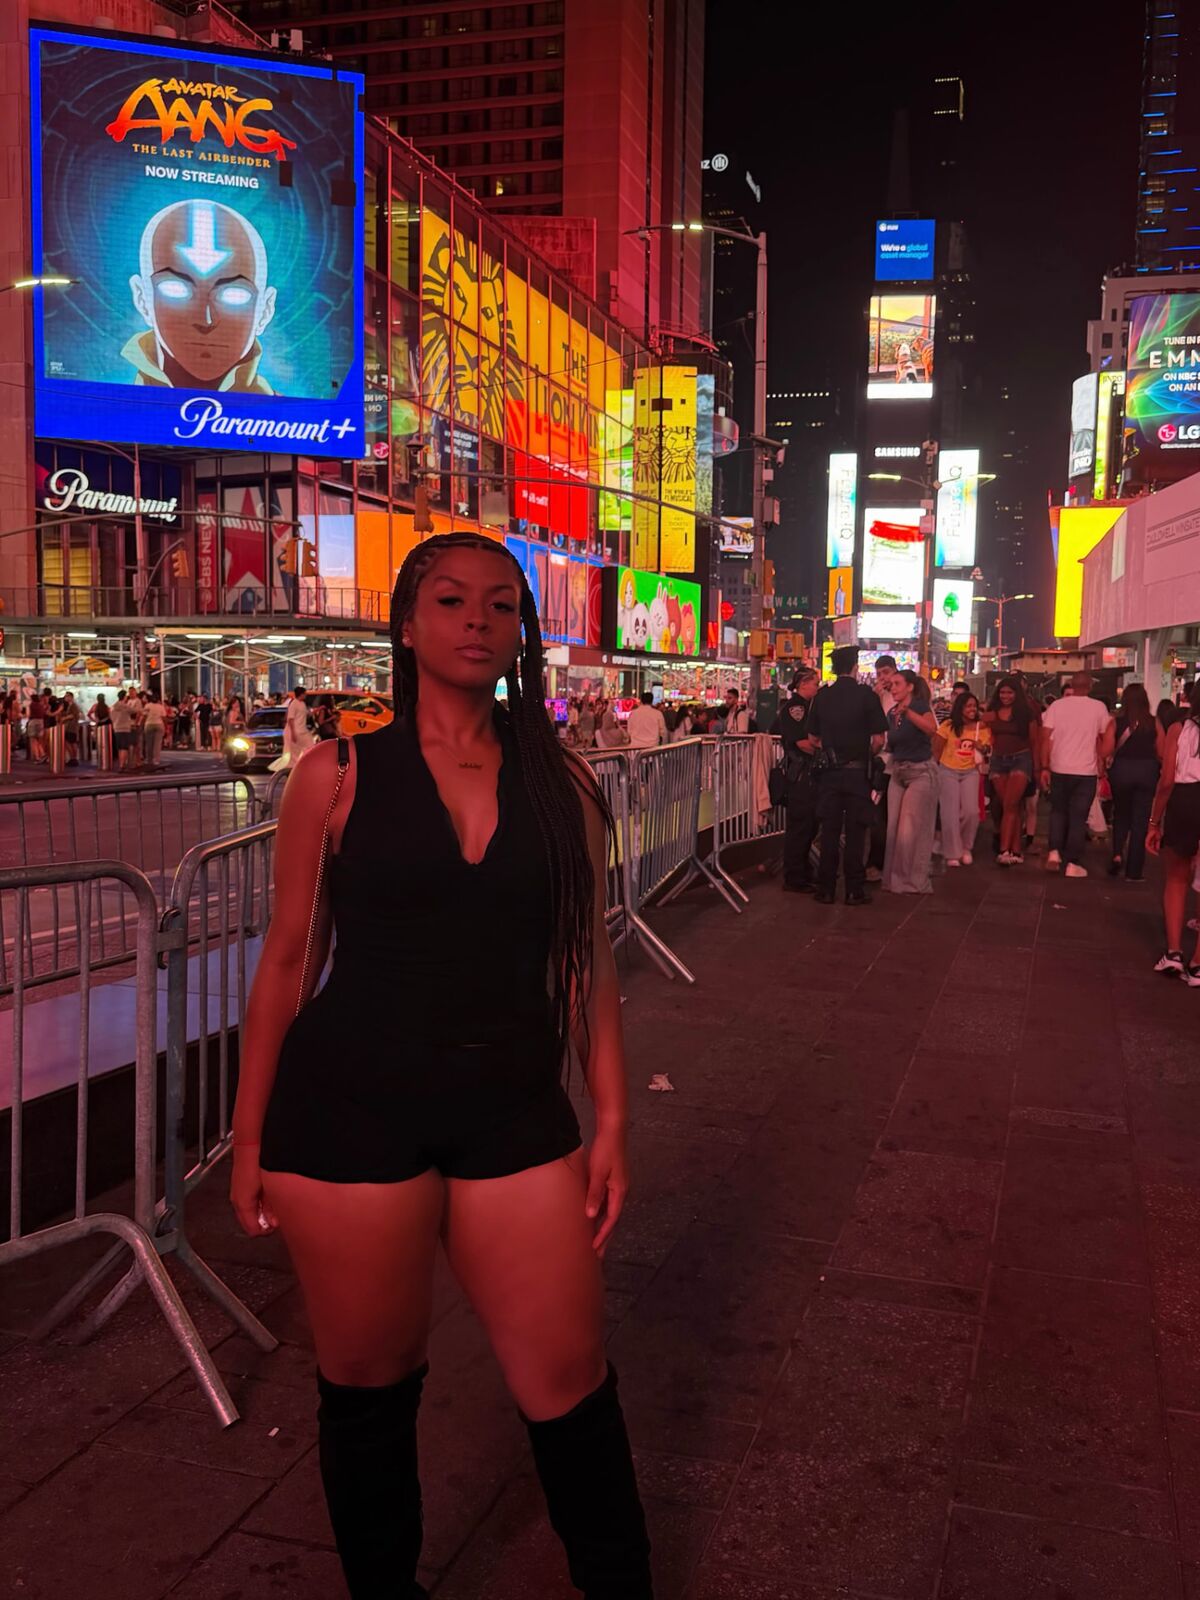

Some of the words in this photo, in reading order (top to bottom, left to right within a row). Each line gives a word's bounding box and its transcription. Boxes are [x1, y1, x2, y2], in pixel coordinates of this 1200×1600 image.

[162, 77, 247, 102] AVATAR
[105, 78, 297, 161] AANG
[132, 143, 157, 155] THE
[162, 147, 194, 159] LAST
[198, 152, 271, 168] AIRBENDER
[145, 165, 179, 180] NOW
[181, 169, 259, 189] STREAMING
[907, 243, 929, 253] global
[899, 252, 930, 260] manager
[1163, 336, 1186, 346] TUNE
[1186, 335, 1197, 345] IN
[562, 341, 588, 384] THE
[1162, 372, 1177, 381] ON
[1168, 383, 1183, 392] ON
[1183, 382, 1197, 392] AN
[174, 397, 356, 444] Paramount+
[1178, 424, 1200, 440] LG
[874, 446, 921, 458] SAMSUNG
[775, 596, 783, 607] W
[786, 596, 798, 607] 44
